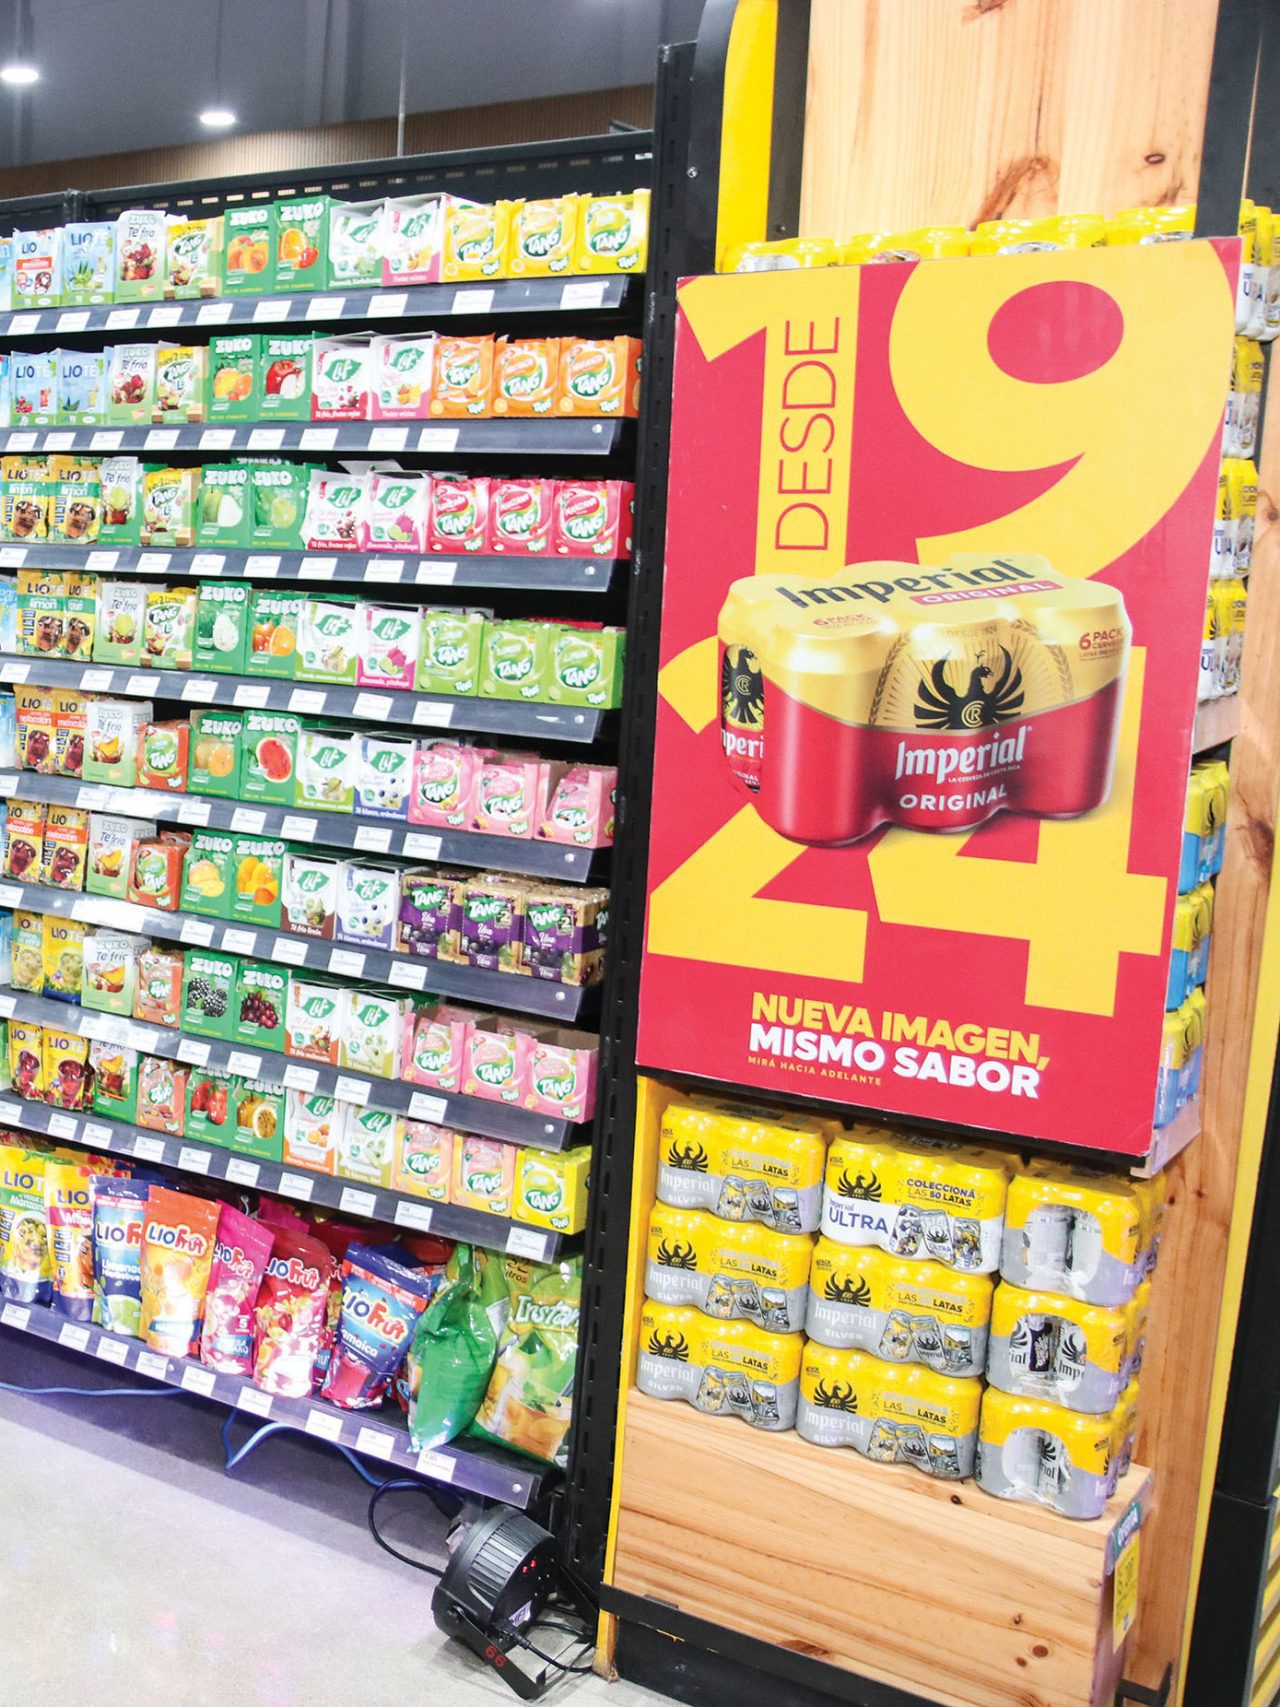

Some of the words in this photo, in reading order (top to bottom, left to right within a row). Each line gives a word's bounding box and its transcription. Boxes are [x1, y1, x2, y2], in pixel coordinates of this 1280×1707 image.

[230, 210, 268, 226] ZUKO
[281, 202, 324, 221] ZUKO
[592, 227, 629, 251] TANG
[215, 338, 252, 352] ZUKO
[269, 340, 312, 354] ZUKO
[503, 372, 540, 397] TANG
[573, 371, 612, 396] TANG
[774, 316, 841, 552] DESDE
[205, 470, 248, 485] ZUKO
[255, 470, 292, 485] ZUKO
[503, 514, 534, 532] TANG
[570, 518, 603, 537] TANG
[200, 586, 245, 601] ZUKO
[775, 559, 1036, 609] Imperial
[921, 580, 1054, 605] ORIGINAL
[256, 600, 299, 616] ZUKO
[1079, 633, 1091, 650] 6
[496, 657, 533, 679] TANG
[561, 663, 599, 688] TANG
[201, 719, 242, 734] ZUKO
[247, 714, 298, 732] ZUKO
[895, 727, 1025, 785] Imperial
[422, 781, 456, 802] TANG
[899, 783, 1007, 811] ORIGINAL
[195, 834, 233, 852] ZUKO
[237, 840, 285, 854] ZUKO
[412, 888, 445, 905] TANG
[469, 900, 500, 917] TANG
[528, 908, 560, 925] TANG
[190, 956, 232, 977] ZUKO
[242, 969, 284, 989] ZUKO
[752, 991, 874, 1039] NUEVA
[881, 1010, 1050, 1071] IMAGEN,
[420, 1053, 452, 1071] TANG
[748, 1023, 886, 1071] MISMO
[893, 1046, 1039, 1099] SABOR
[748, 1055, 776, 1070] MIRÁ
[780, 1061, 815, 1076] HACIA
[821, 1067, 882, 1086] ADELANTE
[476, 1064, 512, 1083] TANG
[538, 1079, 572, 1098] TANG
[407, 1153, 439, 1174] TANG
[762, 1164, 789, 1177] LATAS
[468, 1172, 501, 1193] TANG
[660, 1167, 714, 1194] Imperial
[527, 1191, 561, 1211] TANG
[942, 1192, 971, 1207] LATAS
[828, 1206, 889, 1234] ULTRA
[649, 1266, 704, 1292] Imperial
[751, 1264, 777, 1277] LATAS
[815, 1302, 878, 1329] Imperial
[932, 1299, 963, 1313] LATAS
[641, 1354, 695, 1382] Imperial
[742, 1356, 769, 1370] LATAS
[805, 1407, 864, 1435] Imperial
[917, 1408, 946, 1424] LATAS
